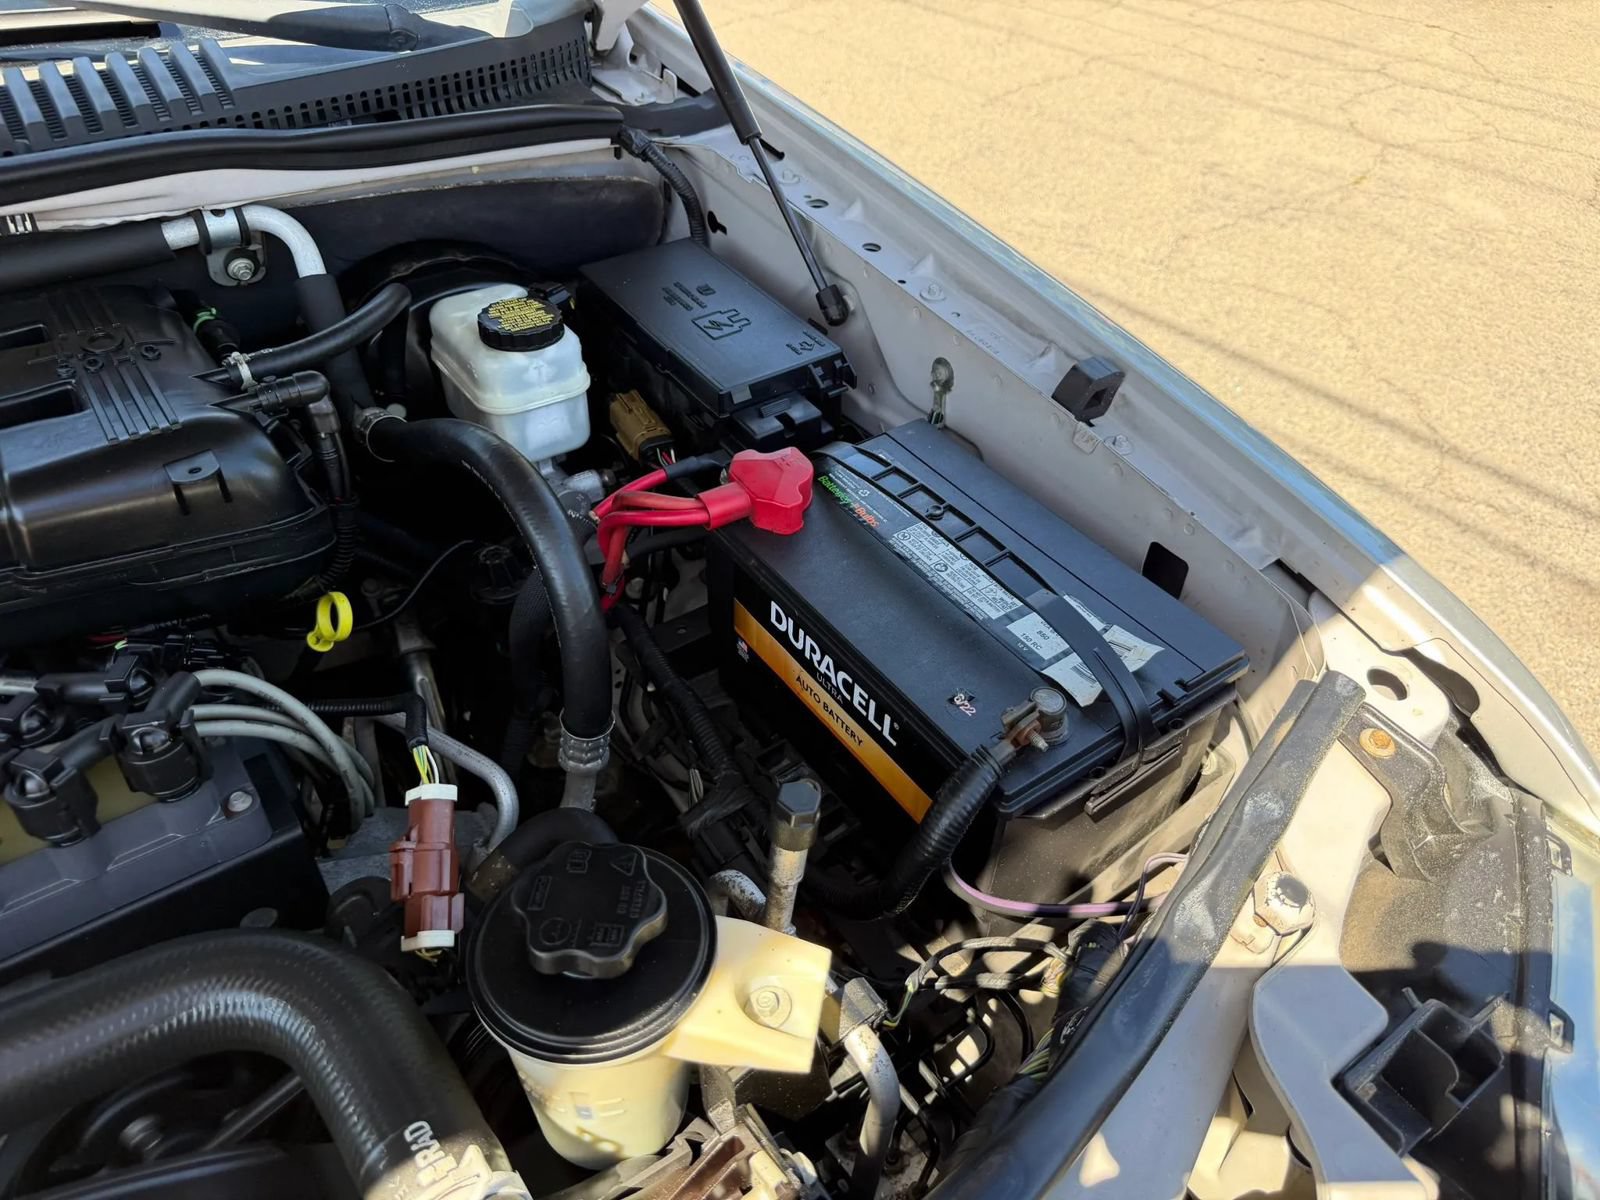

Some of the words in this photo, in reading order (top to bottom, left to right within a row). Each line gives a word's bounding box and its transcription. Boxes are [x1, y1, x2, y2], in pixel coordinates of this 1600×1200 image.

[770, 600, 898, 747] DURACELL
[816, 672, 844, 704] ULTRA
[796, 676, 821, 704] AUTO
[823, 702, 864, 747] BATTERY
[953, 692, 977, 717] 6/22
